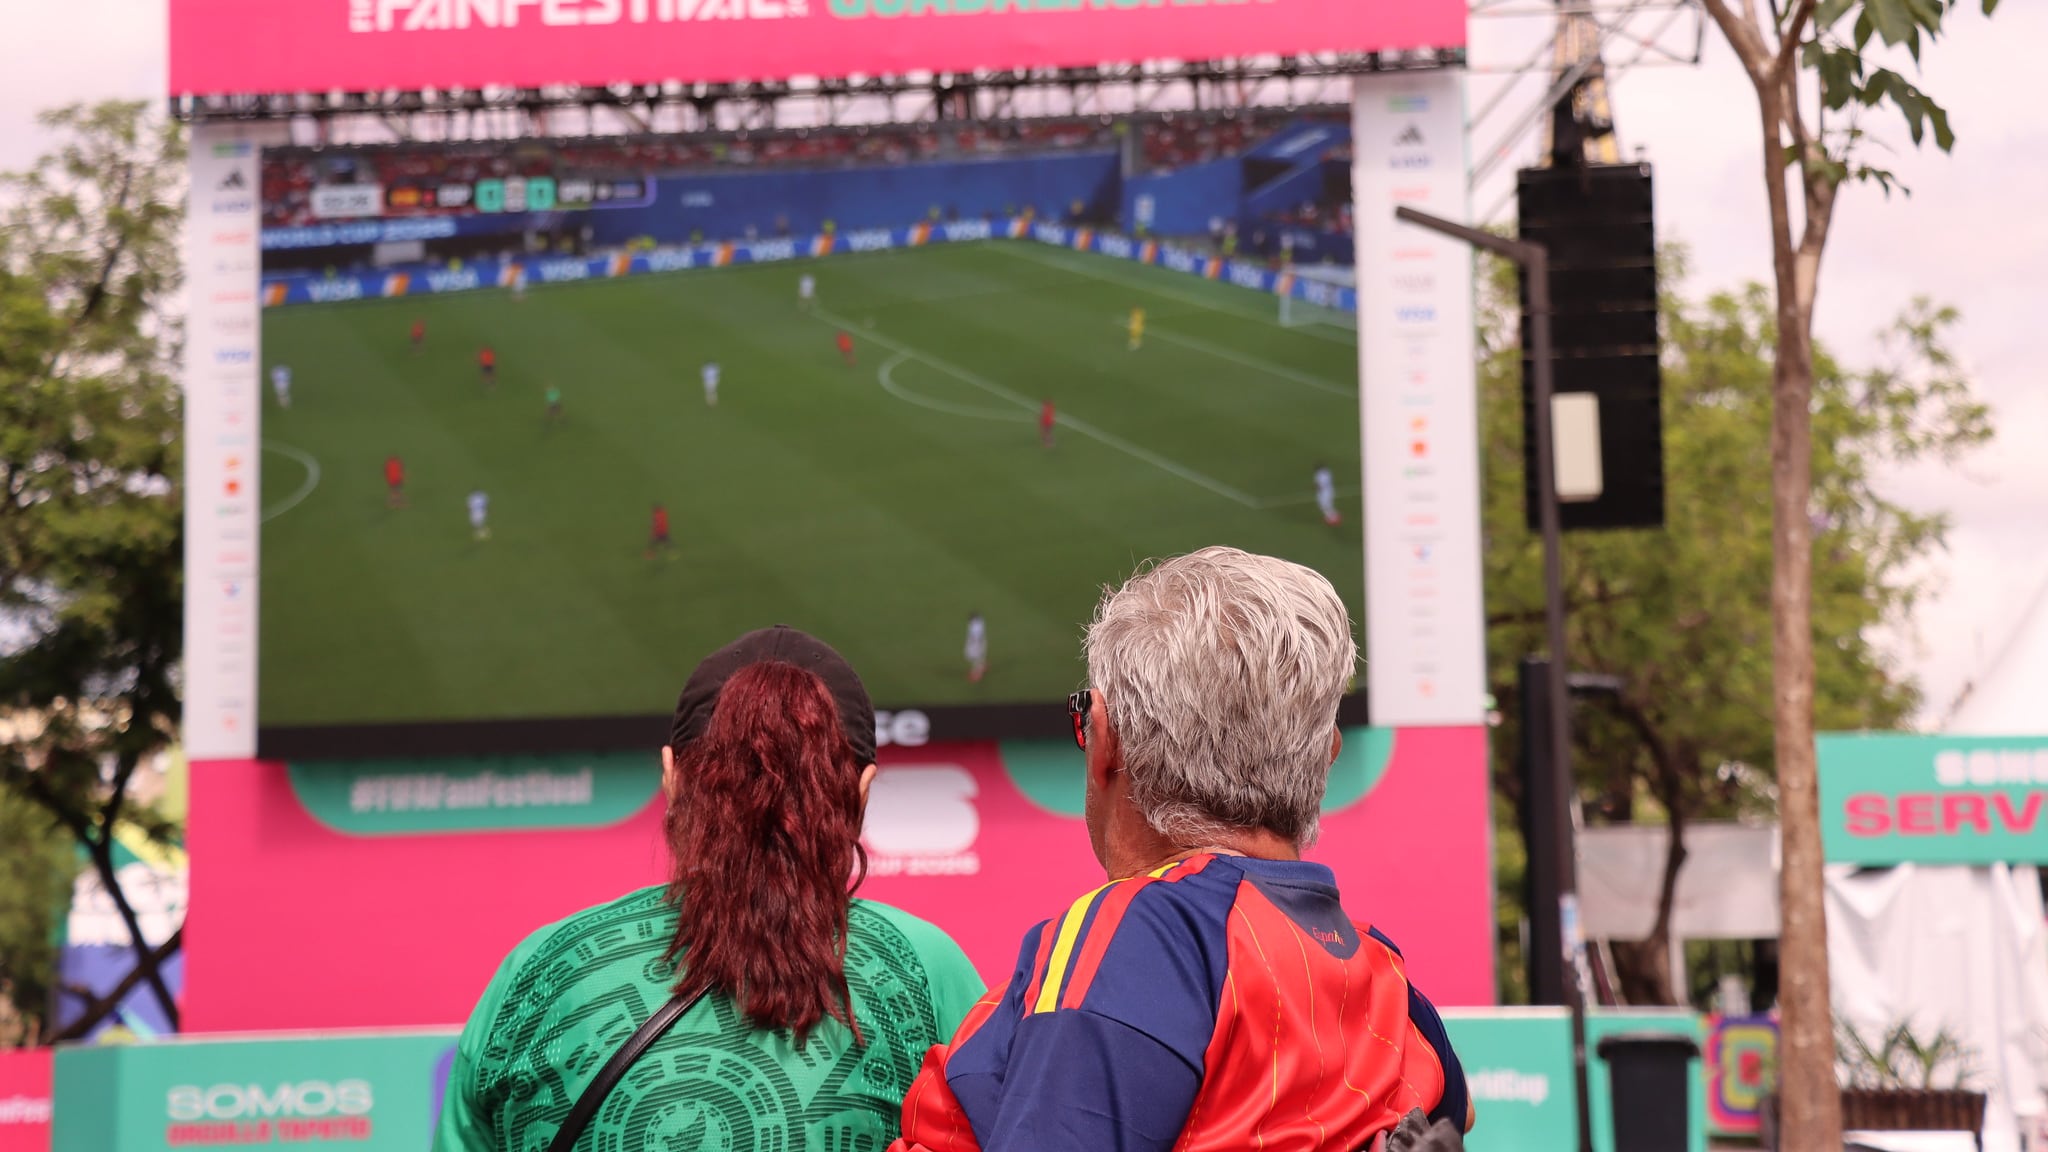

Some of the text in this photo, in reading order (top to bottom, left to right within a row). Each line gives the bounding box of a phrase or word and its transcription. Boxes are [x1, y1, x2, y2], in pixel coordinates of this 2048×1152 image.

[427, 268, 480, 292] VISA
[540, 259, 590, 283] VISA
[307, 276, 363, 302] VISA
[167, 1079, 373, 1121] SOMOS
